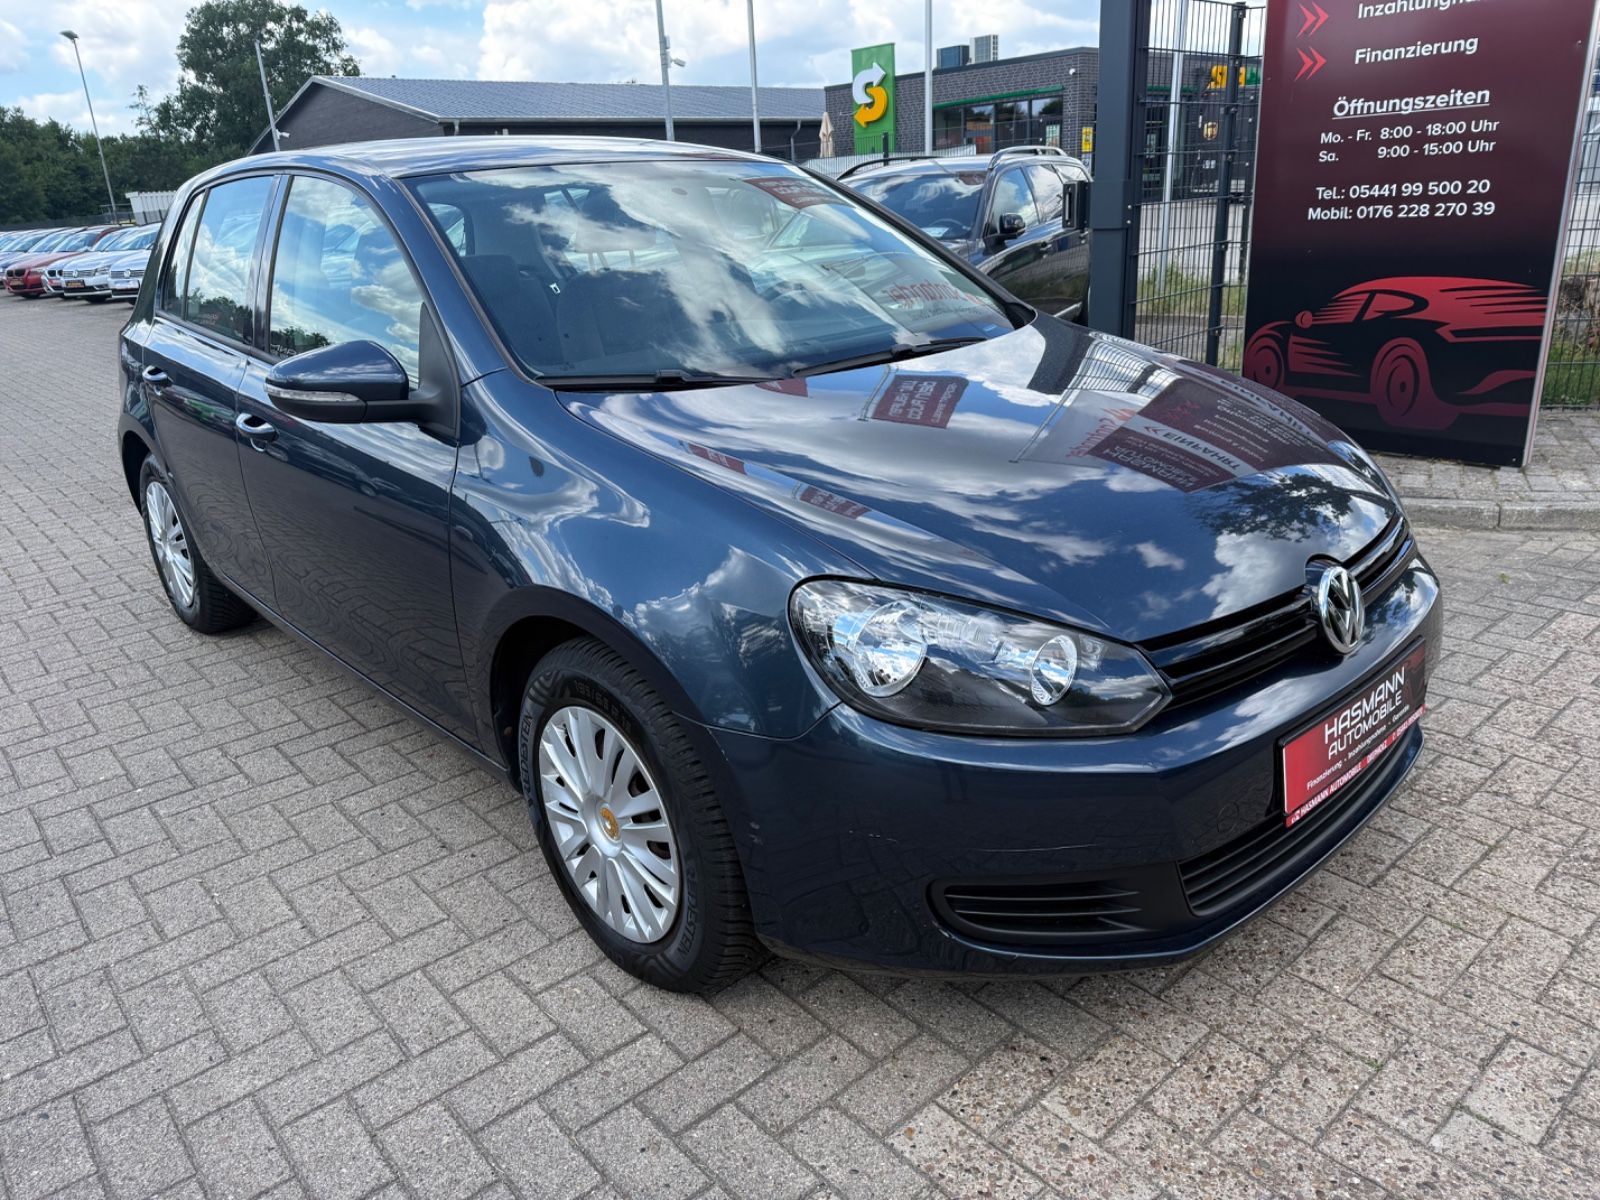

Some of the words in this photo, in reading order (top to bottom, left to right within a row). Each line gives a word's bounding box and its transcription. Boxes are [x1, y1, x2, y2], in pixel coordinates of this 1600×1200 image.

[1358, 0, 1481, 19] Inzahlung
[1354, 37, 1479, 65] Finanzierung
[1332, 88, 1490, 117] Öffnungszeiten
[1320, 132, 1344, 144] Mo.
[1356, 129, 1372, 142] Fr.
[1380, 125, 1413, 140] 8:00
[1426, 121, 1467, 136] 18:00
[1471, 119, 1500, 133] Uhr
[1318, 150, 1340, 162] Sa.
[1377, 144, 1410, 159] 9:00
[1423, 140, 1464, 156] 15:00
[1467, 139, 1496, 153] Uhr
[1316, 186, 1345, 200] Tel.:
[1349, 183, 1396, 198] 05441
[1401, 182, 1423, 197] 99
[1428, 180, 1462, 196] 500
[1467, 179, 1491, 194] 20
[1307, 206, 1353, 220] Mobil:
[1356, 205, 1393, 219] 0176
[1398, 203, 1430, 218] 228
[1434, 202, 1467, 216] 270
[1472, 201, 1496, 216] 39
[1324, 666, 1405, 744] HASMANN
[1328, 690, 1402, 760] AUTOMOBILE
[1306, 760, 1343, 791] Finanzierung
[1329, 761, 1362, 798] AUTOMOBILE
